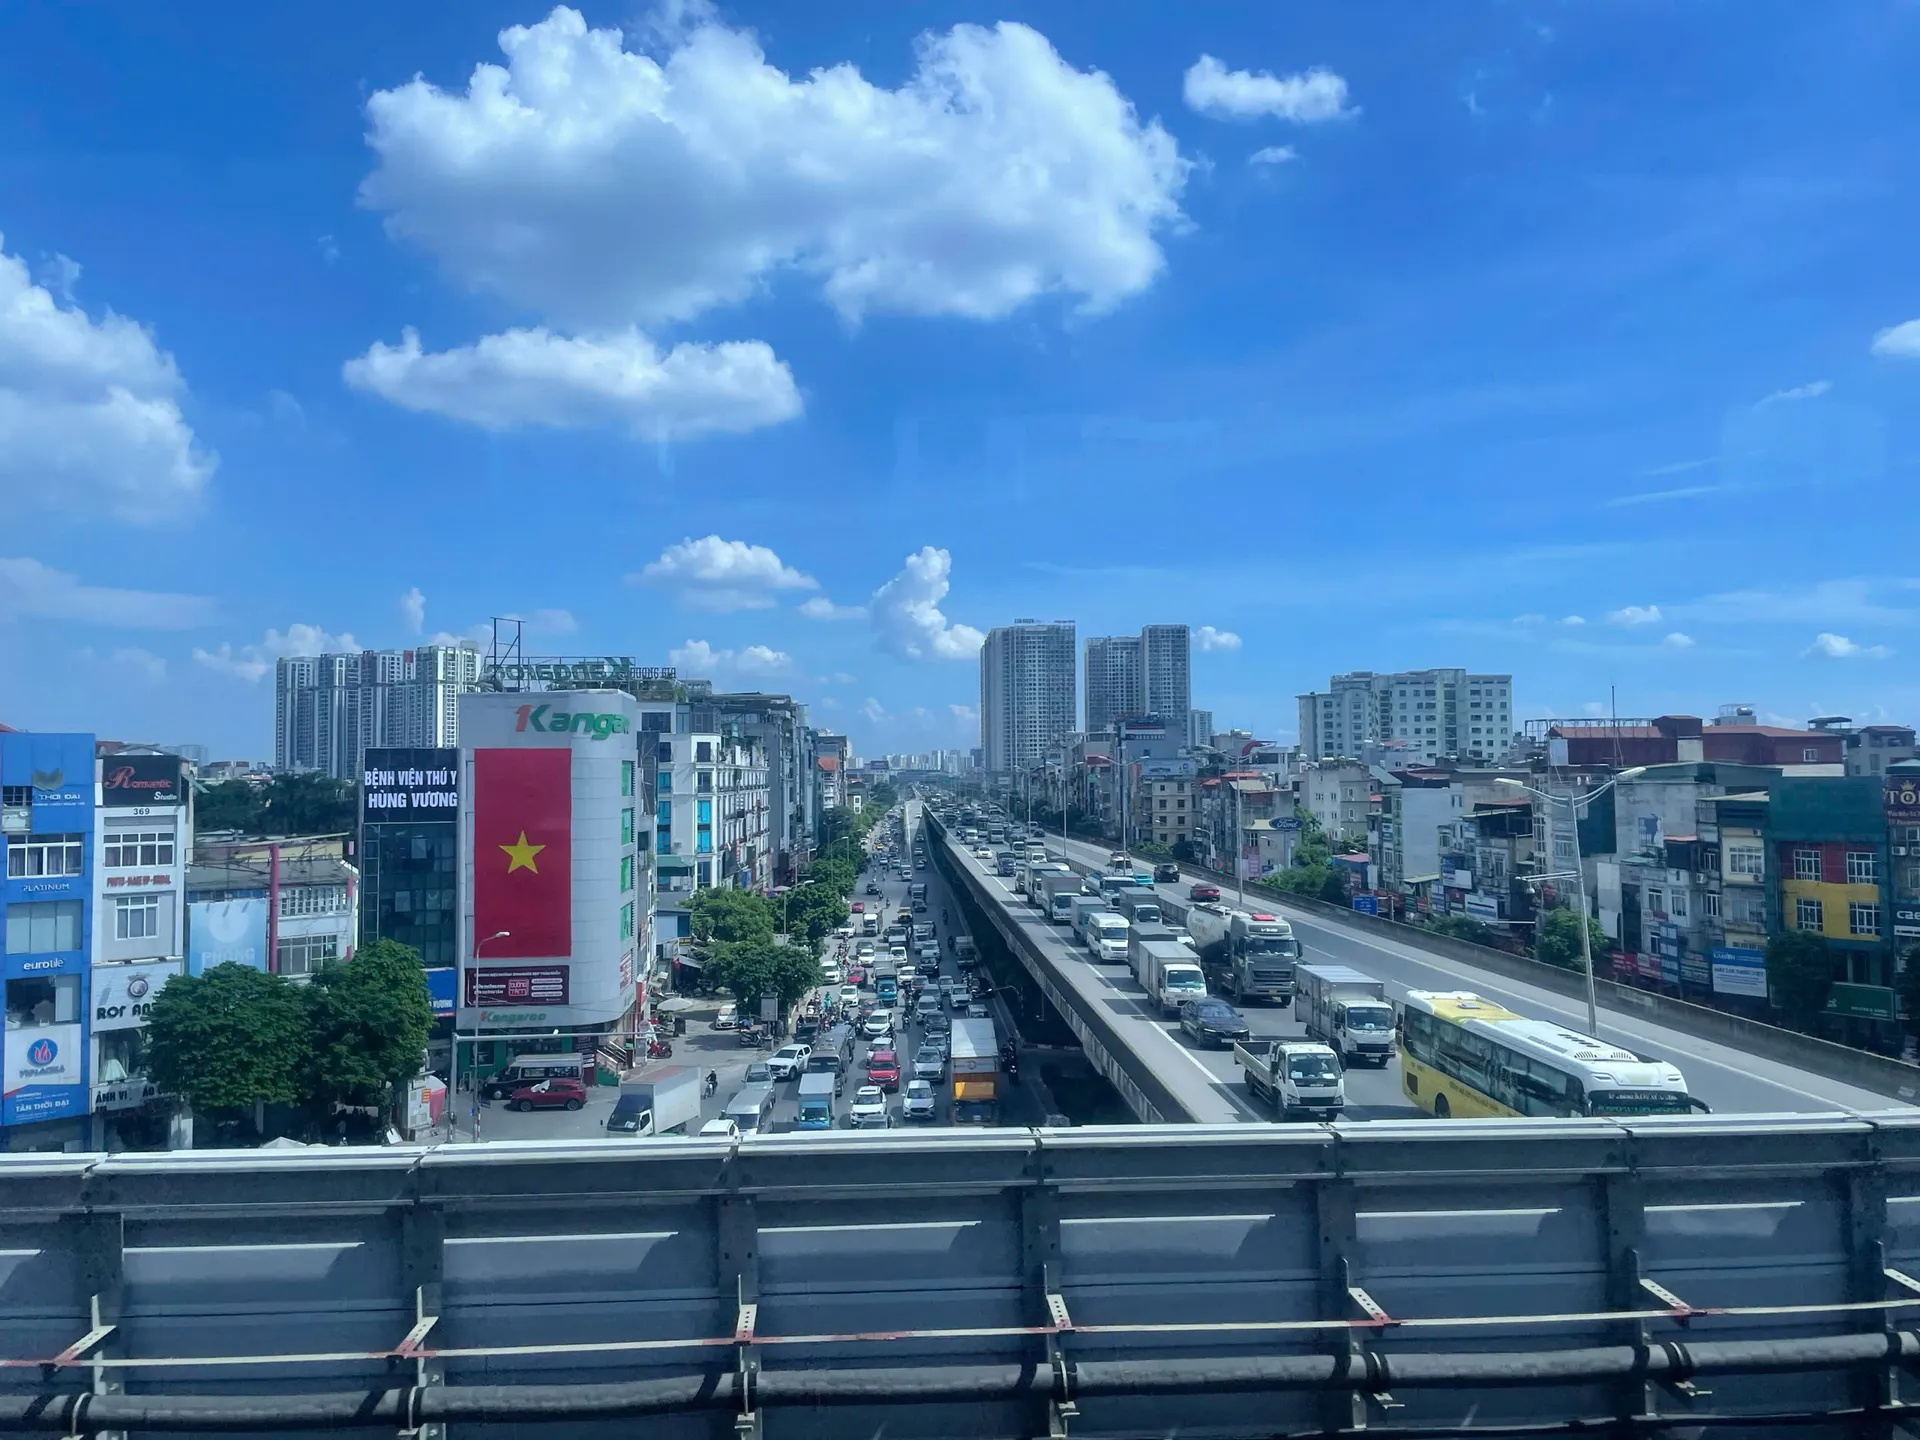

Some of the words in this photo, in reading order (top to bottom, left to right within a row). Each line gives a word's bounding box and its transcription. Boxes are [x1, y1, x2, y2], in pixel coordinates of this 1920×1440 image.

[104, 766, 173, 789] Romantic
[364, 767, 395, 789] BỆNH
[398, 767, 424, 789] VIỆN
[426, 766, 447, 785] THÚ
[450, 770, 457, 785] Y
[368, 789, 407, 808] HÙNG
[411, 791, 458, 808] VƯƠNG
[21, 883, 69, 892] PLATINUM
[23, 958, 64, 970] eurotile
